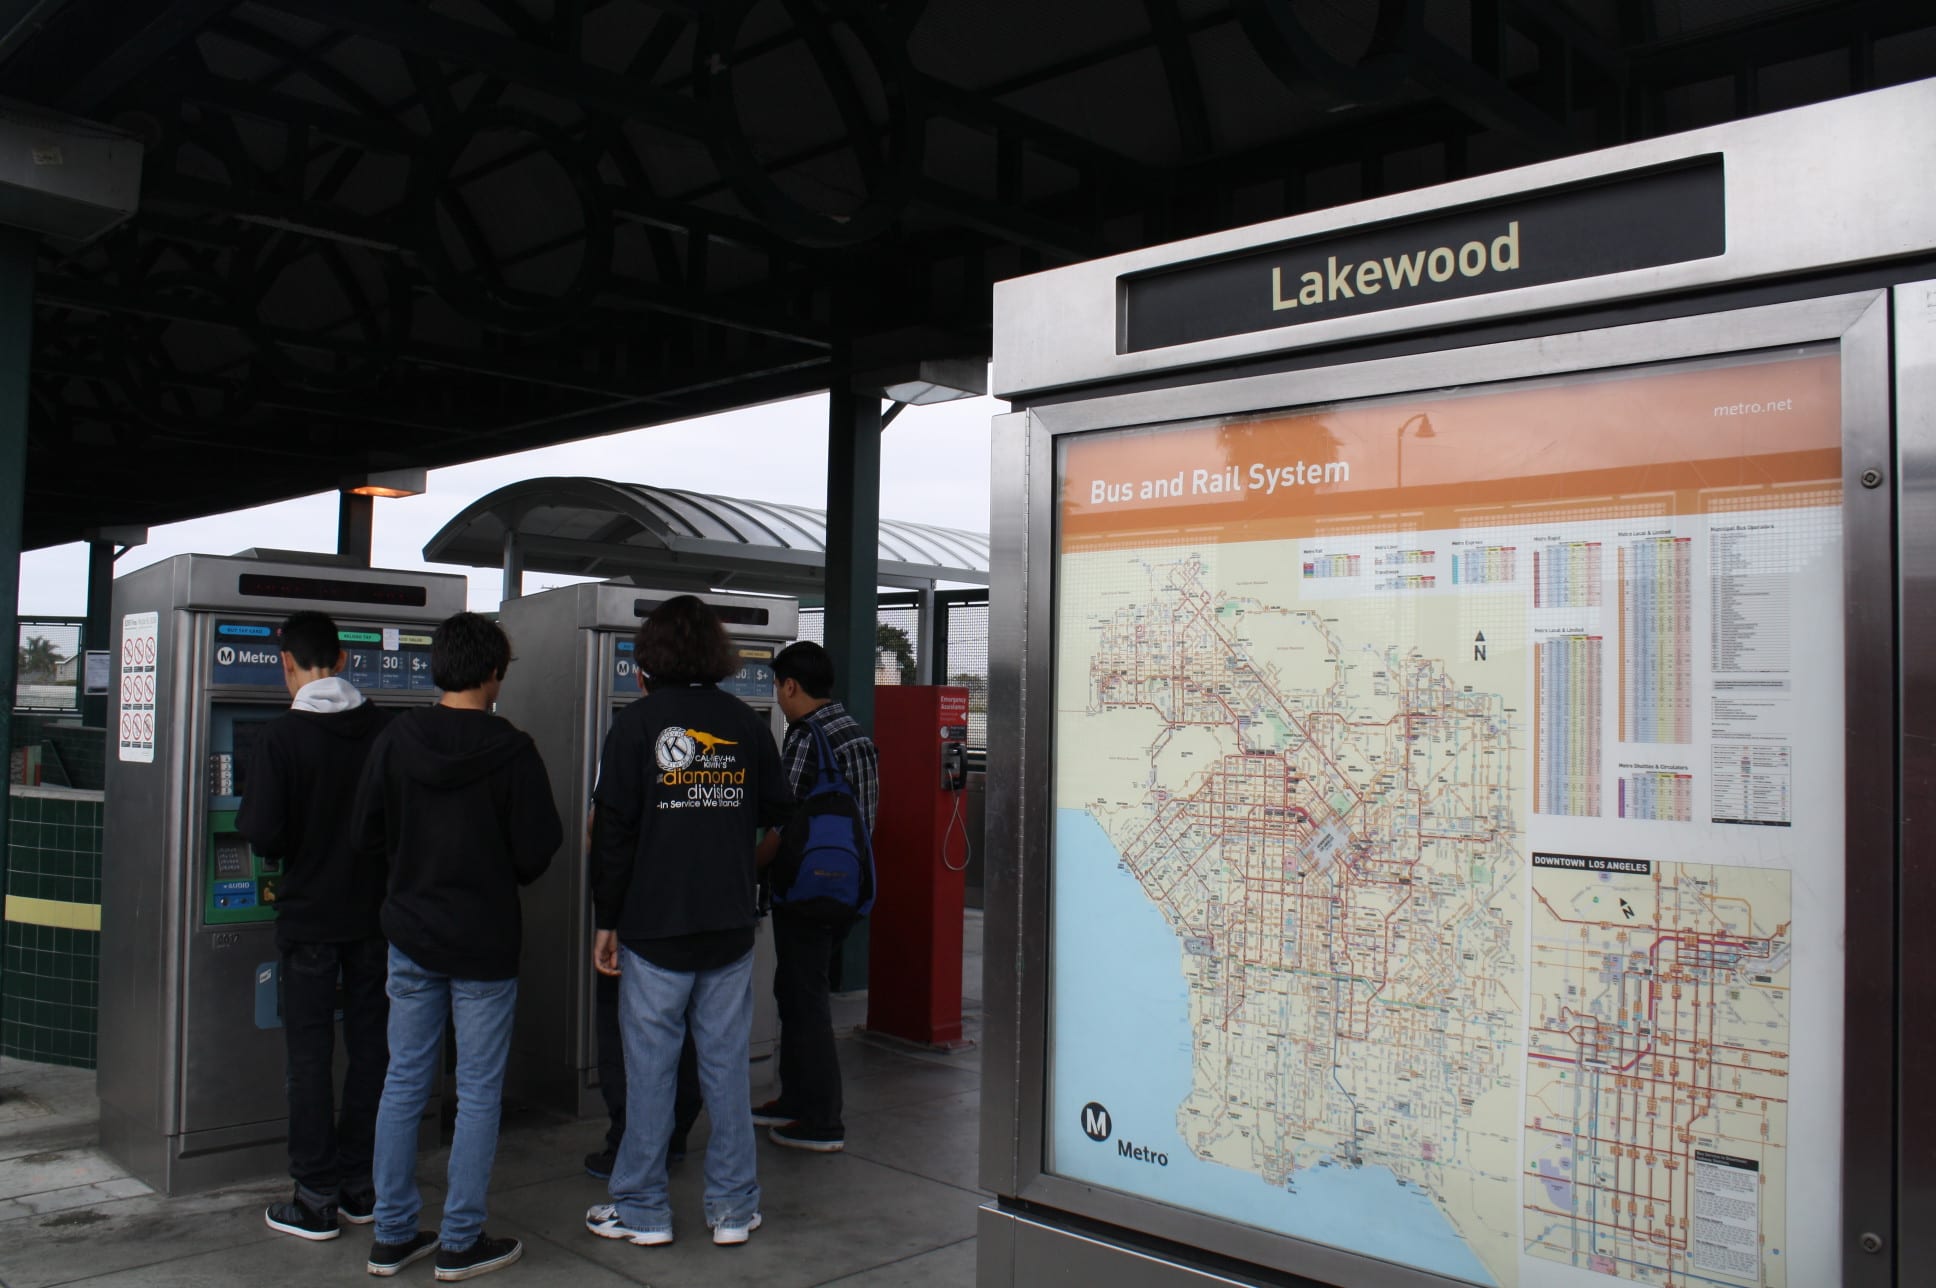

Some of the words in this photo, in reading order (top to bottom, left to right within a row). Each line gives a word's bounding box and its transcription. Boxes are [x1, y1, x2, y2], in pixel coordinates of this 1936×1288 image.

[1272, 221, 1520, 311] Lakewood
[1714, 398, 1793, 417] metro.net
[1090, 479, 1133, 505] Bus
[1139, 471, 1184, 499] and
[1191, 465, 1241, 495] Rail
[1248, 460, 1350, 494] System
[239, 650, 278, 664] Metro
[353, 654, 361, 668] 7
[1474, 644, 1486, 661] N
[383, 656, 398, 669] 30
[663, 768, 746, 786] diamond
[687, 784, 744, 800] division
[1534, 856, 1585, 868] DOWNTOWN
[1588, 861, 1606, 870] LOS
[1607, 862, 1648, 873] ANGELES
[1117, 1139, 1168, 1167] Metro
